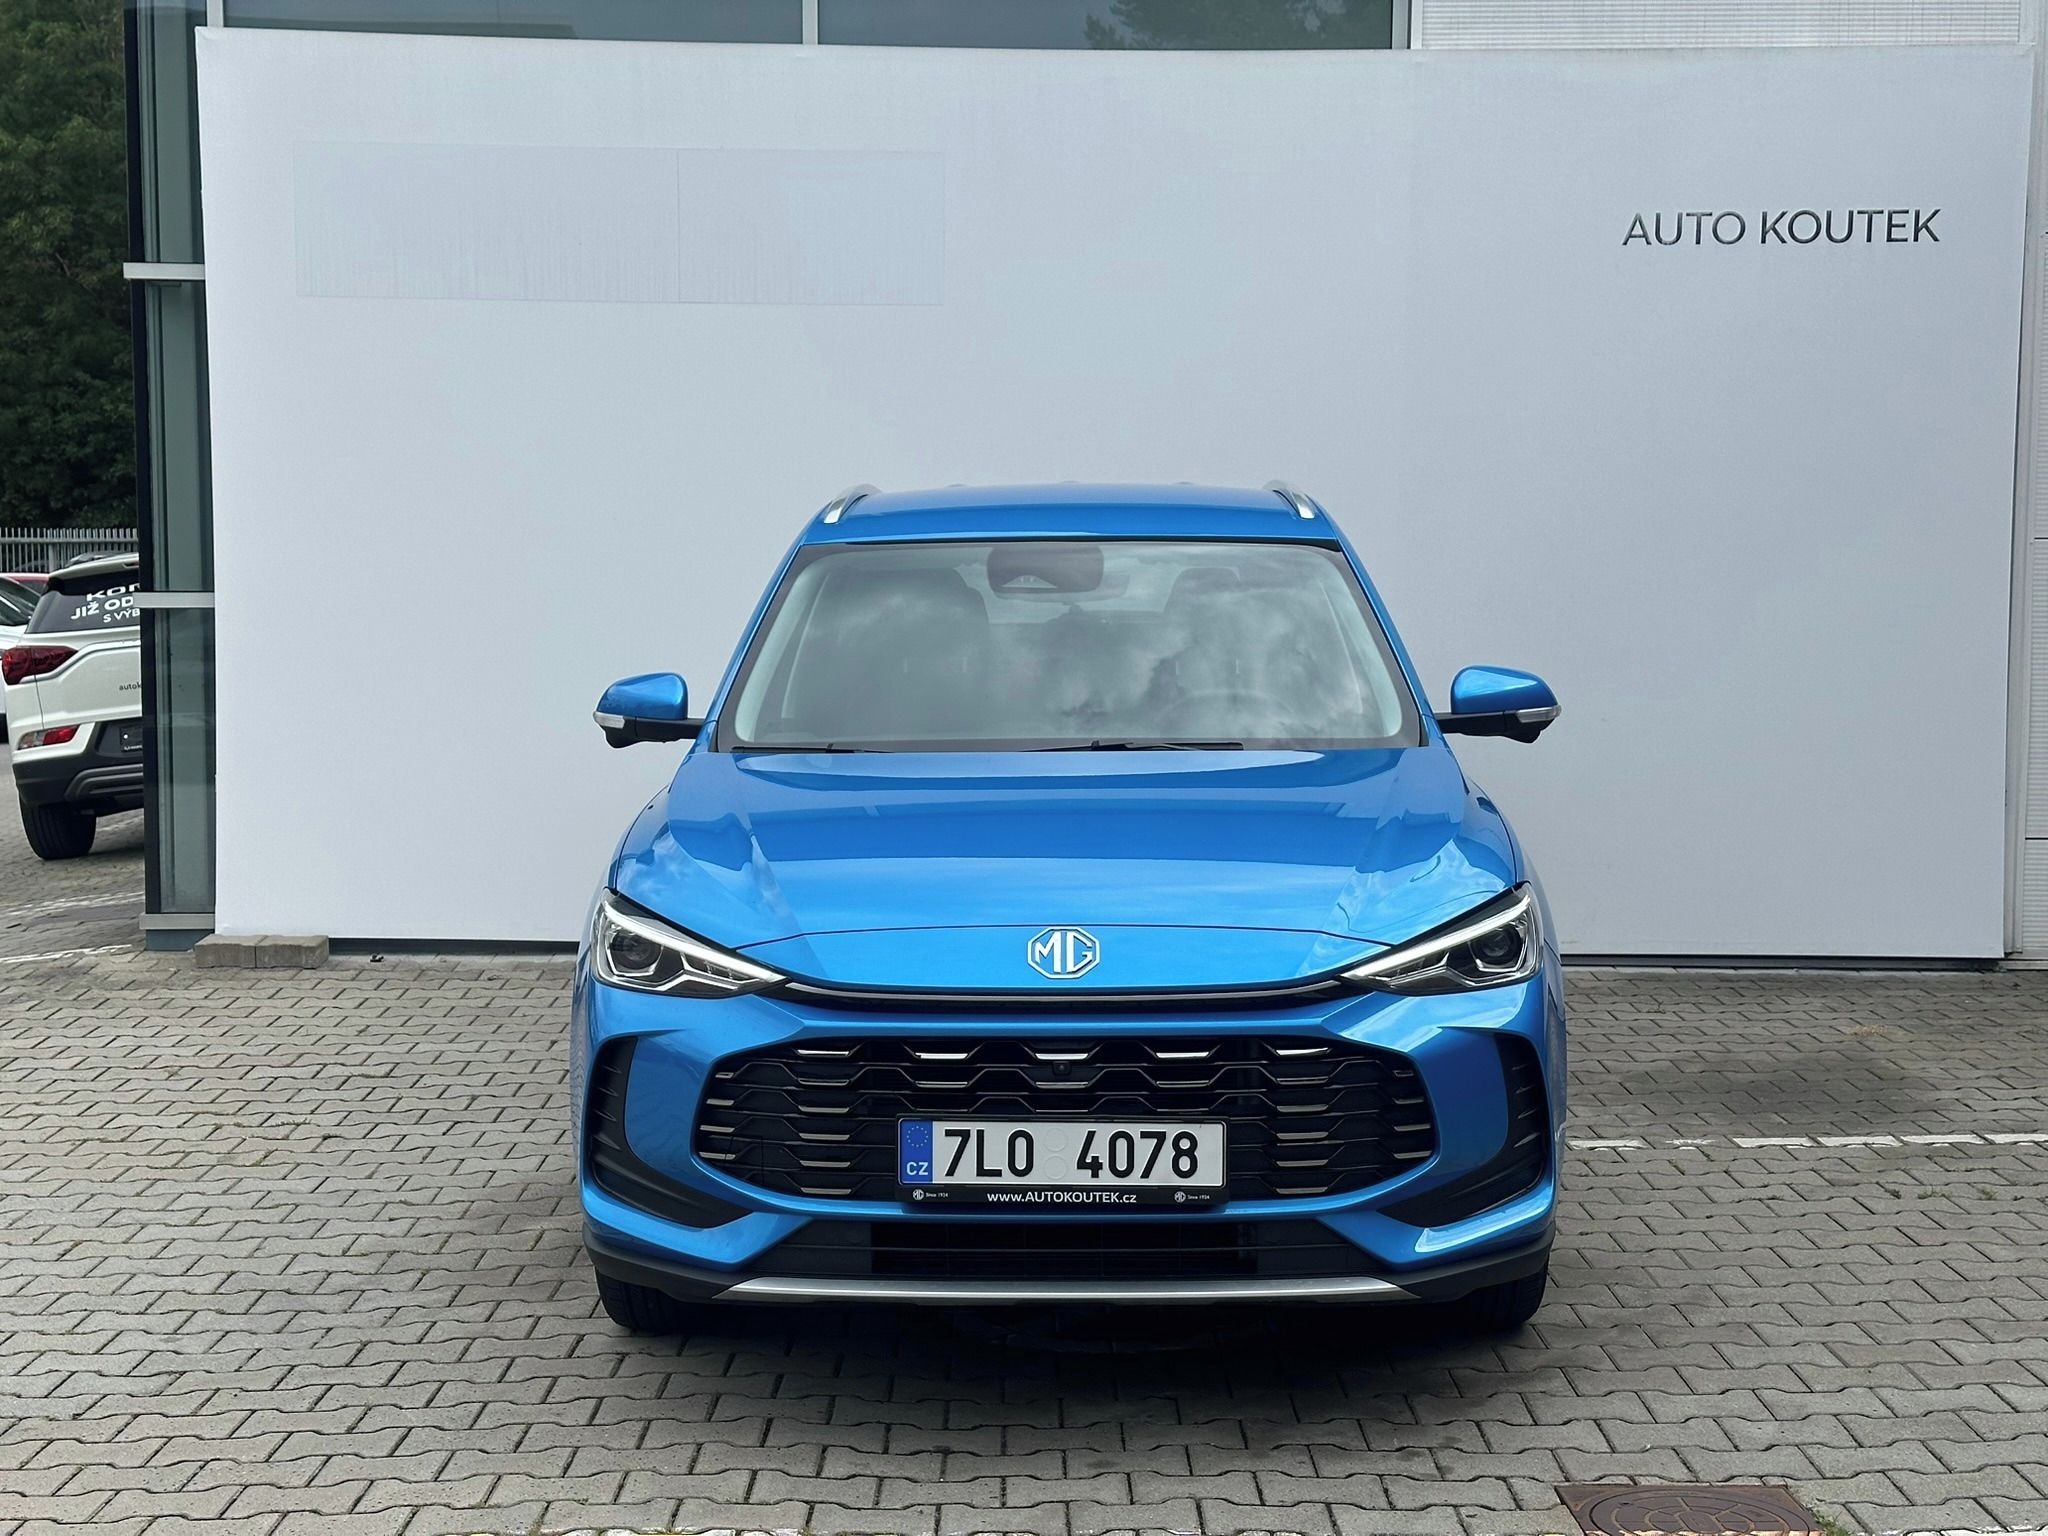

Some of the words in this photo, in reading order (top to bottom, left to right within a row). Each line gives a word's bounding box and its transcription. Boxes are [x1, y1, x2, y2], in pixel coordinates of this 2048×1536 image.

[1622, 210, 1746, 246] AUTO
[1760, 208, 1942, 245] KOUTEK
[70, 601, 100, 620] JIŽ
[103, 613, 112, 623] S
[1033, 930, 1094, 974] MG
[944, 1128, 1035, 1178] 7L0
[1076, 1129, 1199, 1179] 4078
[906, 1161, 929, 1176] CZ
[987, 1191, 1137, 1203] www.AUTOKOUTEK.cz
